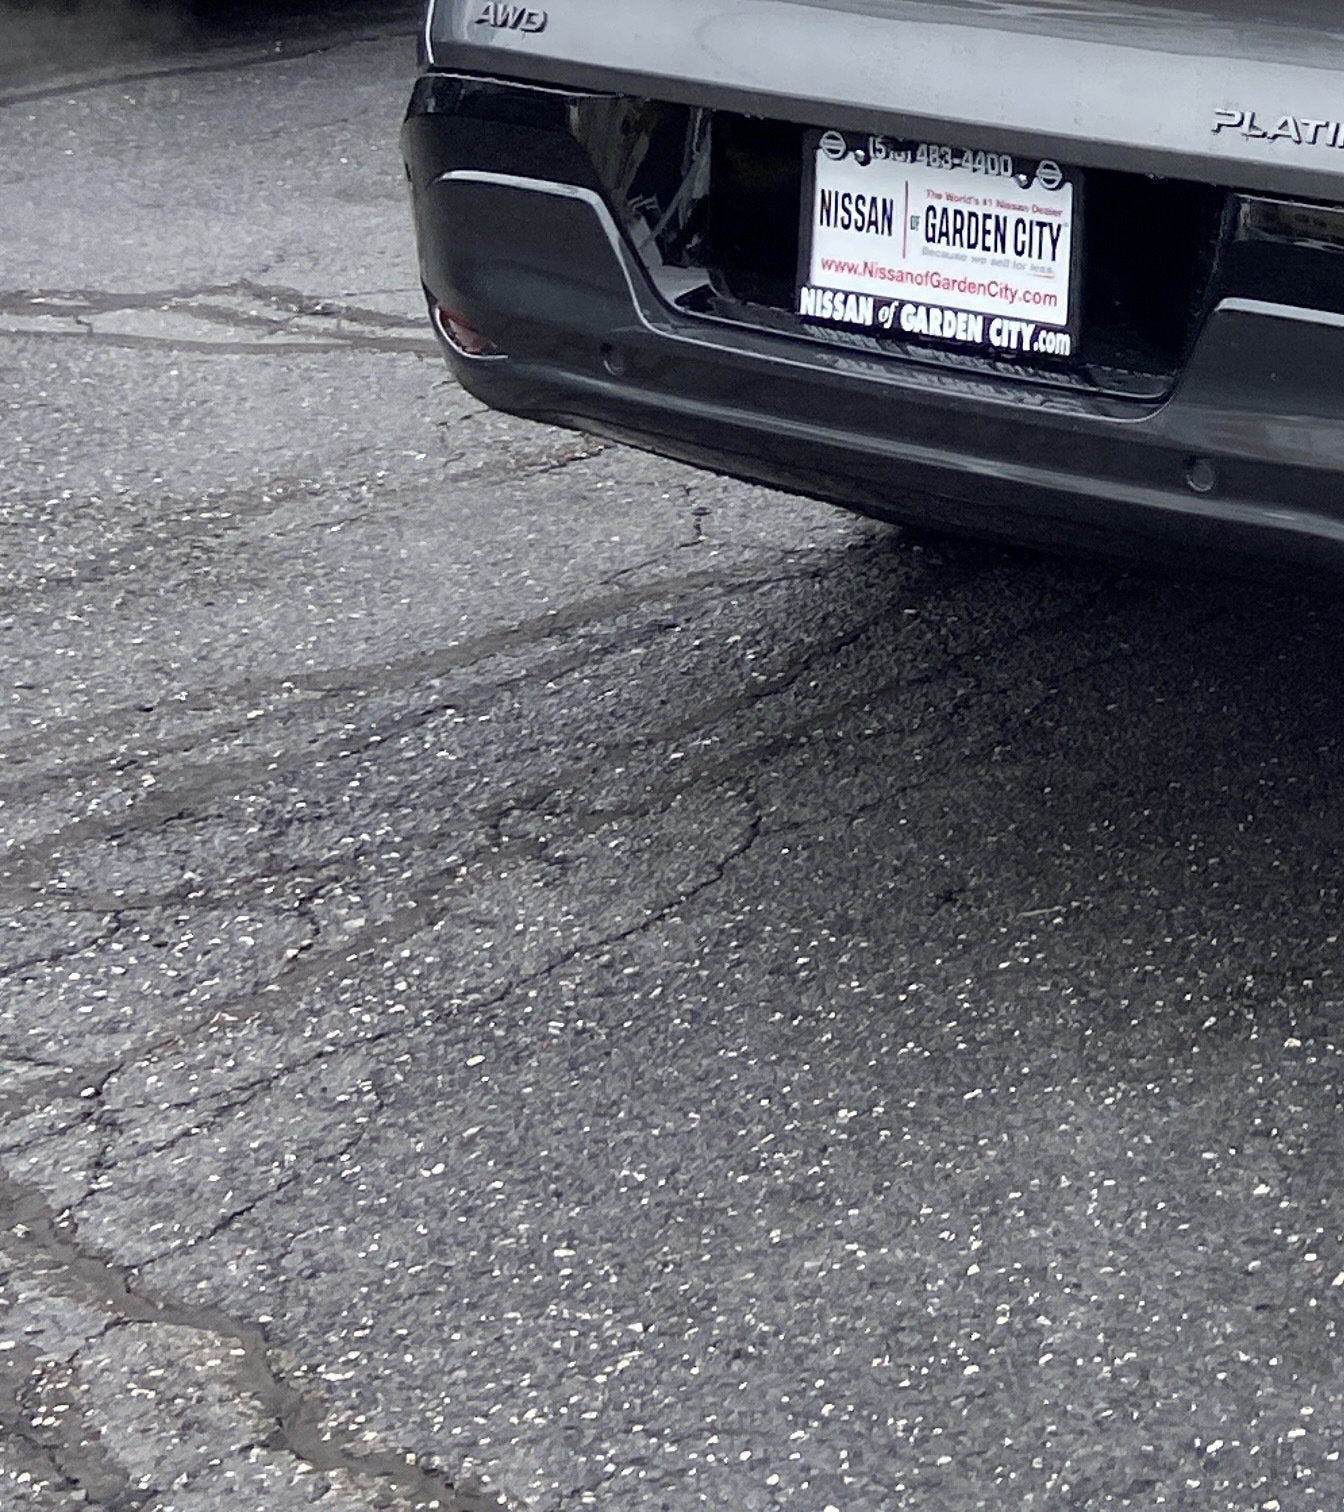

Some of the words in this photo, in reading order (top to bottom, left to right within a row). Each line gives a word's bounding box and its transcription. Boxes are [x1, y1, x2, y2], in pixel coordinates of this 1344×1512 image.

[474, 1, 549, 33] AWD
[915, 143, 1014, 178] 483-4400
[925, 189, 943, 201] The
[945, 191, 980, 205] World's
[995, 199, 1029, 212] Nissan
[1031, 204, 1064, 217] Dealer
[819, 188, 894, 237] NISSAN
[925, 204, 1008, 255] GARDEN
[1013, 217, 1062, 262] CITY
[922, 246, 968, 262] Because
[820, 255, 1059, 307] www.NissanofGardenCity.com
[801, 286, 874, 326] NISSAN
[878, 299, 899, 329] of
[900, 303, 982, 343] GARDEN
[988, 317, 1071, 357] CITY.com
